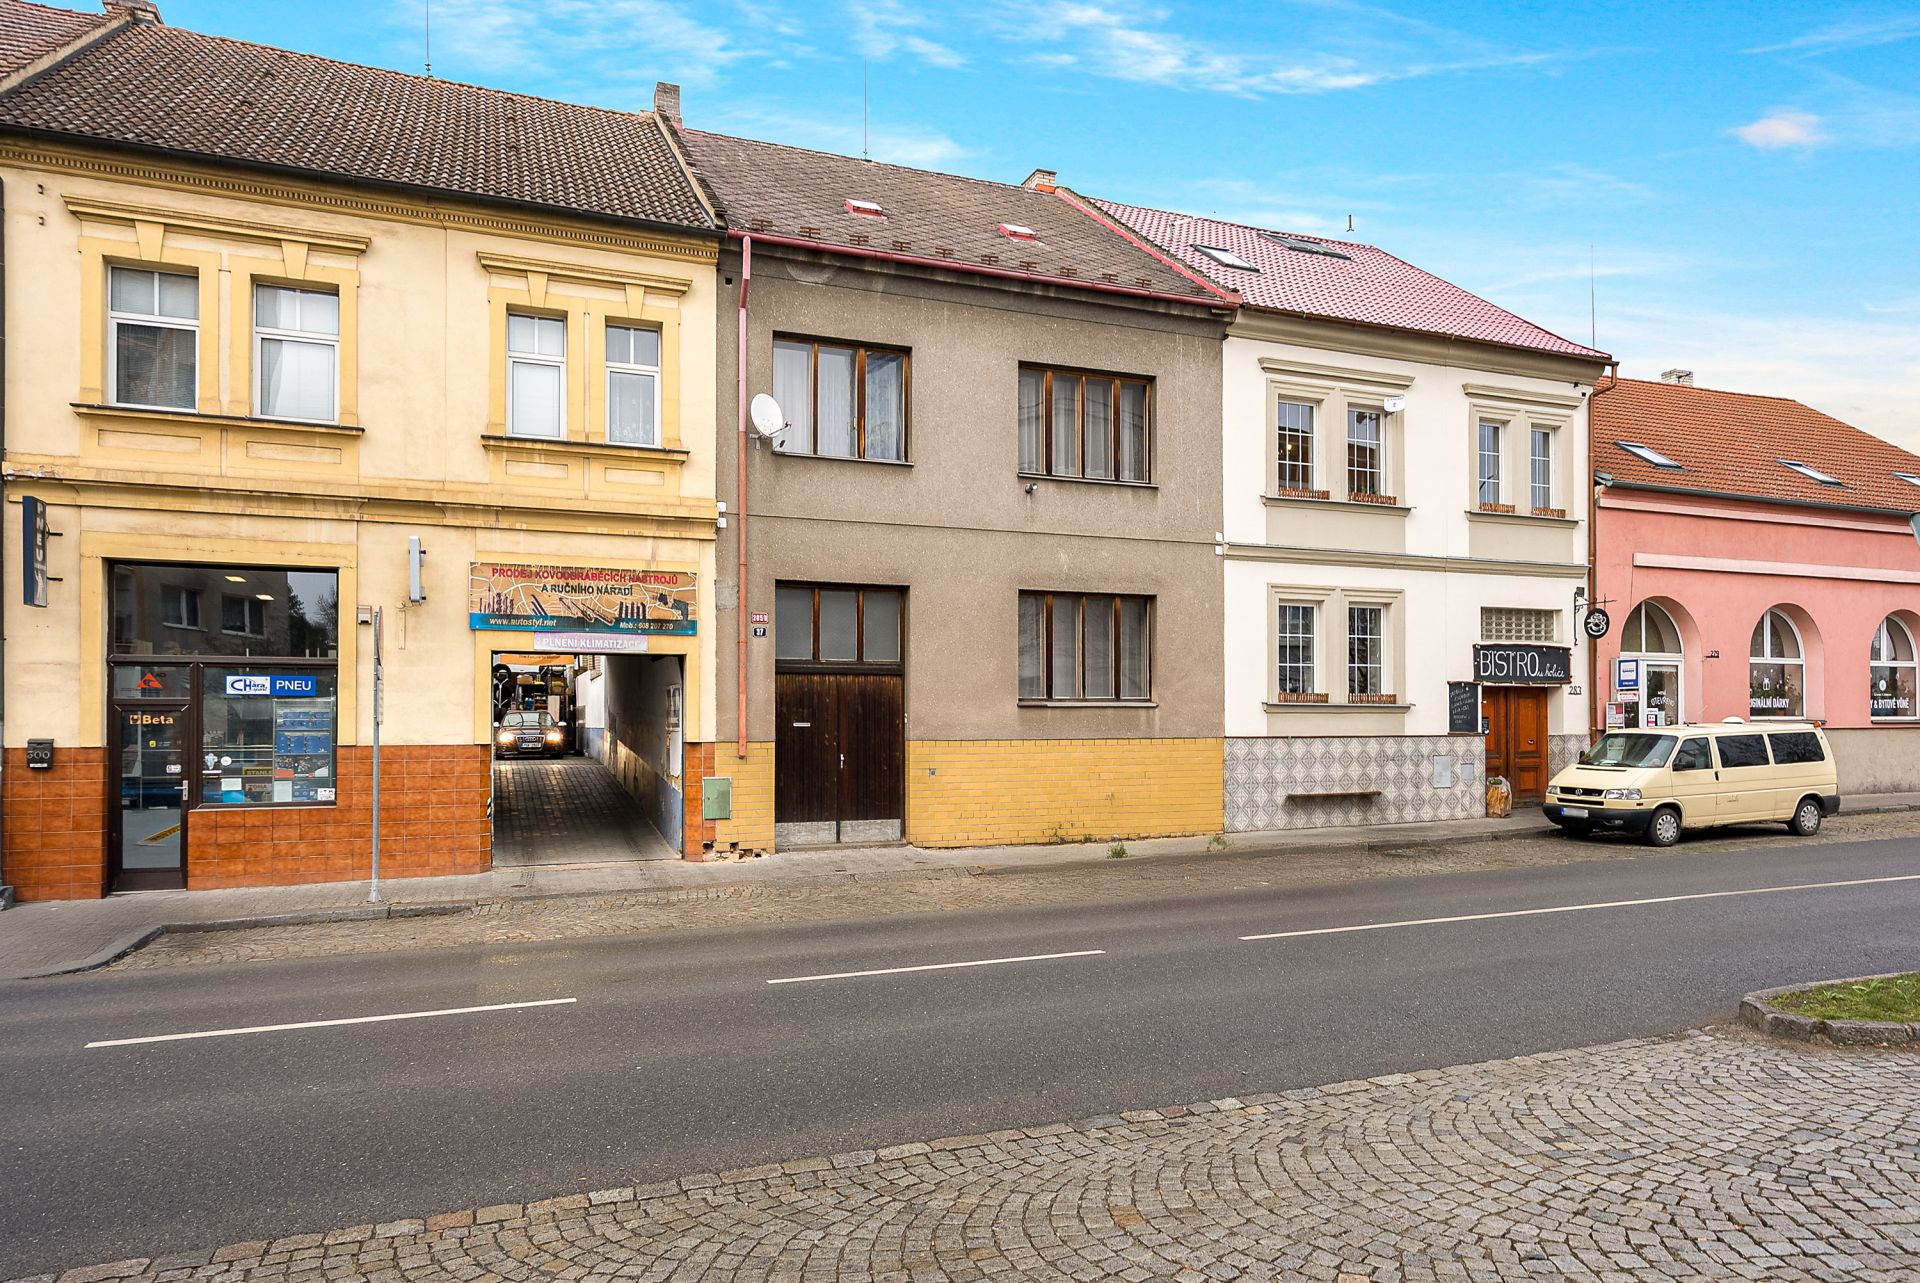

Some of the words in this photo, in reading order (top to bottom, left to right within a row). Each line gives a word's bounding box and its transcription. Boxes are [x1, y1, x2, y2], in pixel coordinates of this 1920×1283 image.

[492, 568, 533, 579] PRODEJ
[541, 584, 548, 593] A
[550, 582, 594, 595] RUČNÍHO
[596, 584, 633, 596] NÁŘADÍ
[489, 618, 557, 628] www.autostyl.net
[578, 639, 641, 649] KLIMATIZACE
[1480, 650, 1539, 677] BISTRO
[276, 680, 312, 691] PNEU
[1569, 686, 1582, 694] 283
[1772, 696, 1790, 708] DÁRKY
[1879, 697, 1896, 709] BYTOVÉ
[142, 715, 174, 725] Beta
